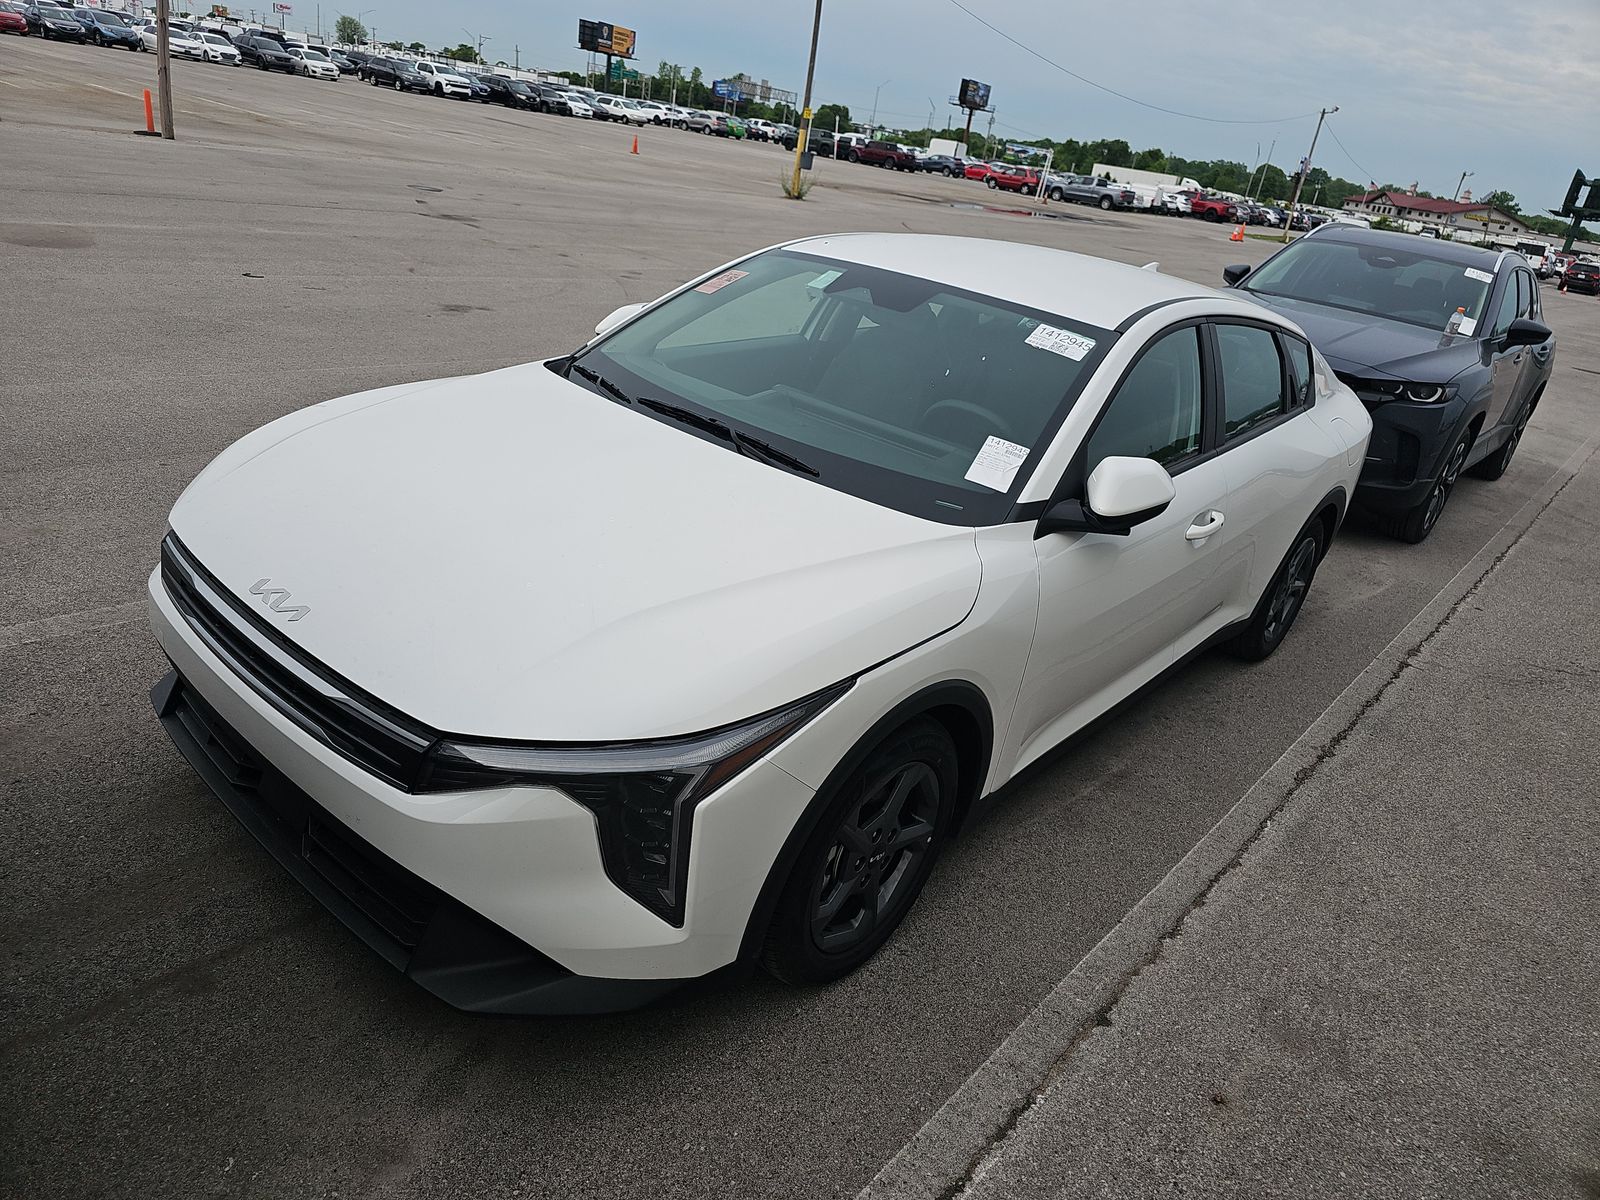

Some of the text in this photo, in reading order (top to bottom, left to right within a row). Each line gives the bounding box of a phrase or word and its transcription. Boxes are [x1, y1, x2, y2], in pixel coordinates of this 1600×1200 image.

[1039, 327, 1093, 352] 1412945
[990, 438, 1030, 456] 1412945
[248, 578, 312, 622] KIA
